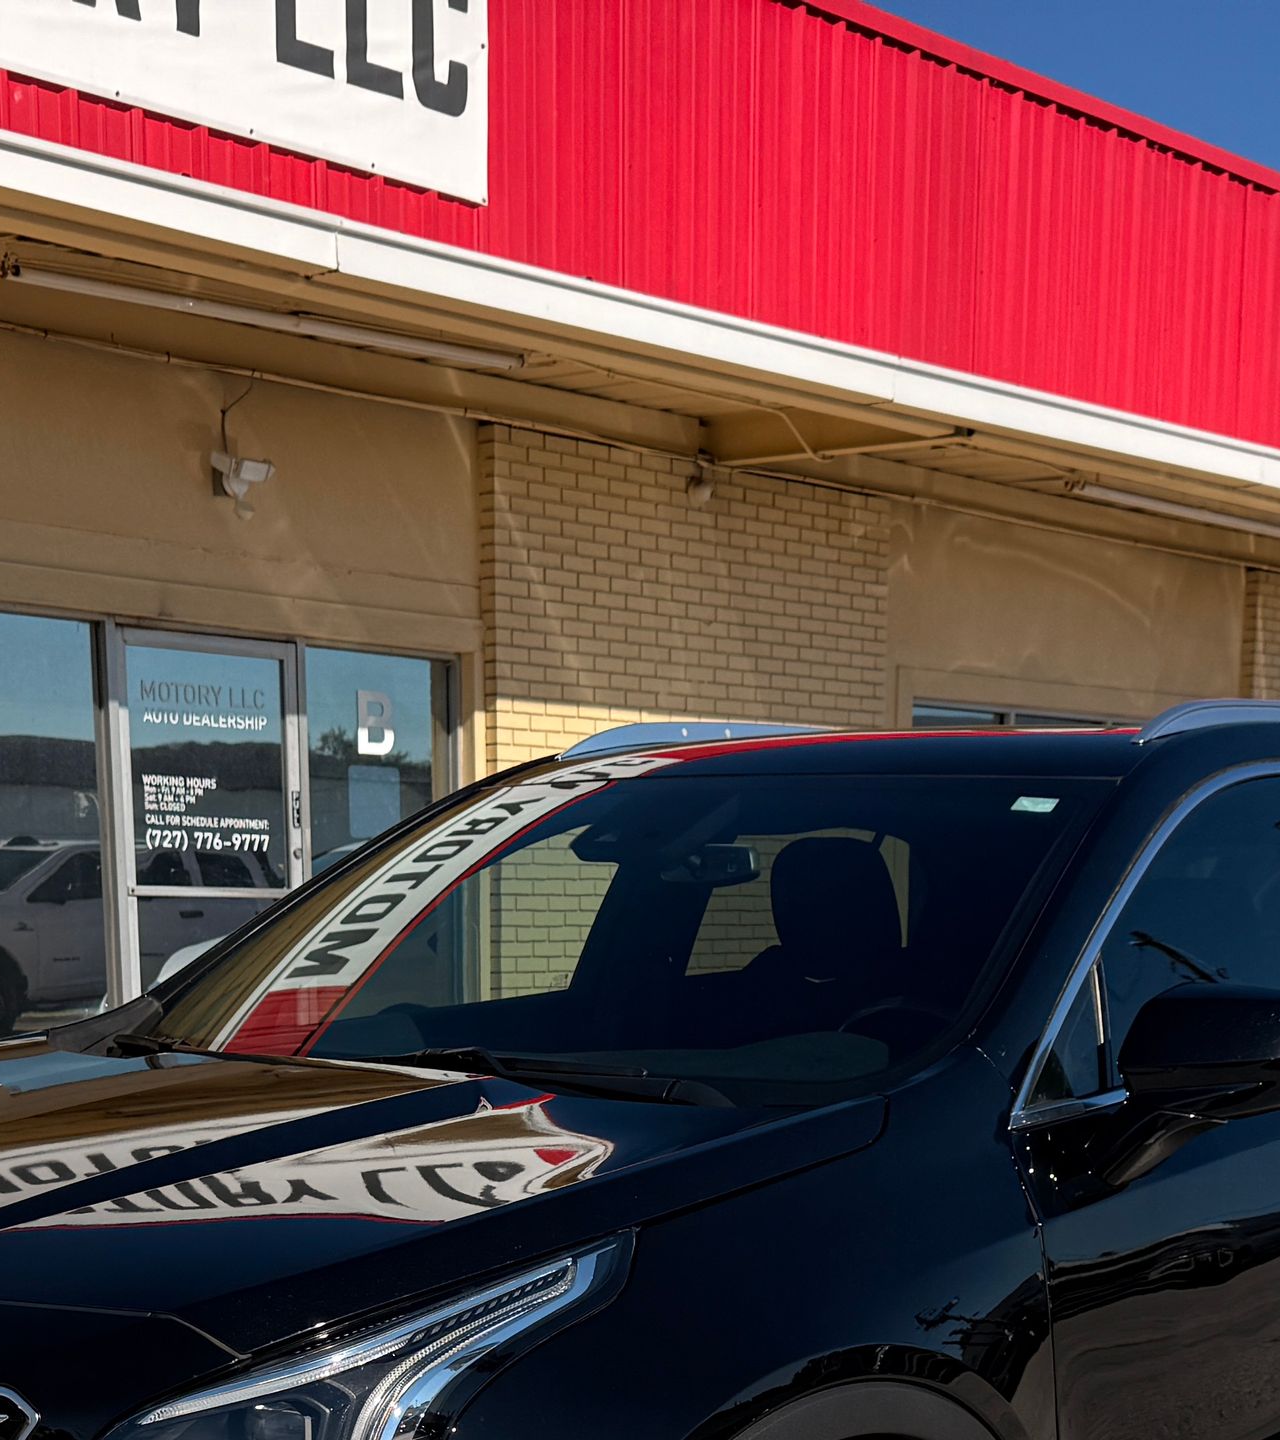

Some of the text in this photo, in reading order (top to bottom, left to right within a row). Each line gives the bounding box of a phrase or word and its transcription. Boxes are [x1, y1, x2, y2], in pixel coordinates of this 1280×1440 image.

[140, 680, 265, 710] MOTORY LLC
[143, 709, 267, 731] AUTO DEALERSHIP
[356, 689, 395, 756] B
[142, 774, 217, 790] WORKING HOURS
[160, 802, 186, 812] CLOSED
[145, 813, 165, 825] CALL
[166, 815, 180, 826] FOR
[181, 815, 219, 828] SCHEDULE
[145, 828, 270, 852] (727) 776-9777
